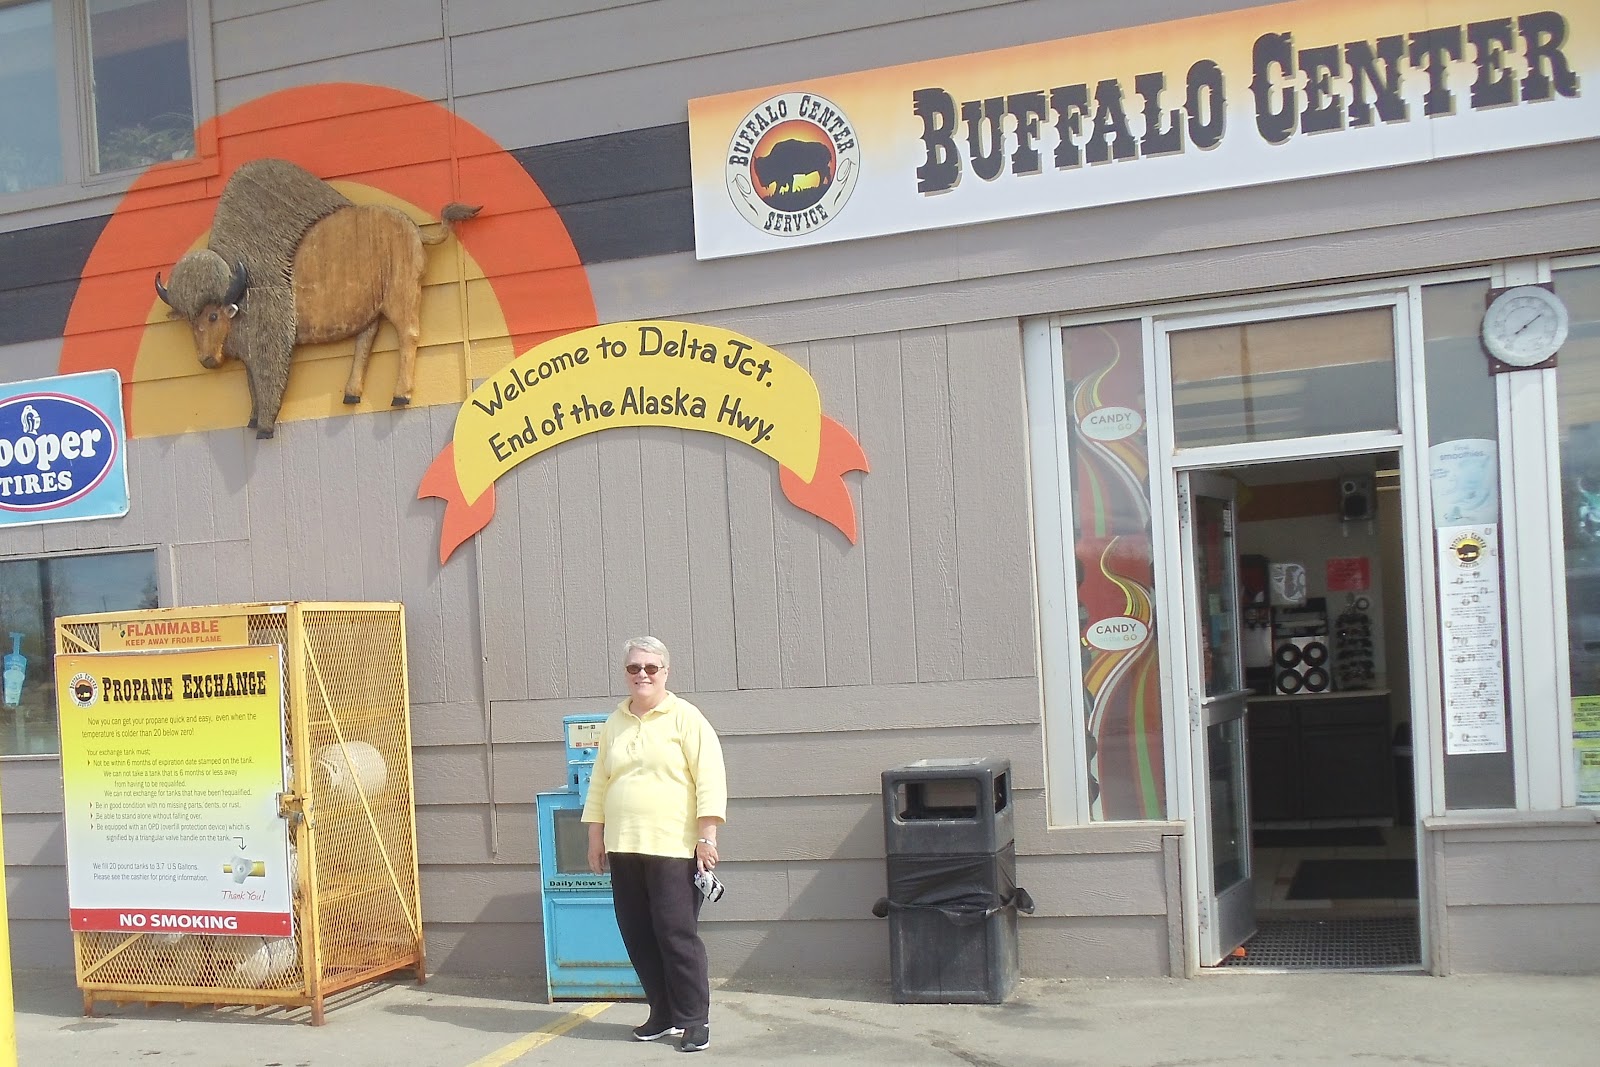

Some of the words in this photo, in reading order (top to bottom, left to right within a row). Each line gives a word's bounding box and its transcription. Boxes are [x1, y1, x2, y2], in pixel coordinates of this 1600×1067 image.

[912, 57, 1226, 197] BUFFALO
[1248, 10, 1580, 145] CENTER
[729, 100, 787, 166] BUFFALO
[799, 95, 855, 154] CENTER
[764, 203, 828, 232] SERVICE
[472, 343, 589, 417] Welcome
[597, 336, 627, 360] to
[638, 326, 716, 363] Delta
[724, 339, 773, 388] Jct.
[489, 416, 537, 462] End
[541, 402, 565, 437] of
[571, 395, 615, 426] the
[621, 386, 706, 420] Alaska
[717, 394, 775, 444] Hwy.
[1090, 413, 1131, 425] CANDY
[0, 428, 102, 471] ooper
[0, 470, 73, 497] TIRES
[127, 620, 219, 637] FLAMMABLE
[1096, 623, 1137, 635] CANDY
[125, 639, 146, 647] KEEP
[148, 637, 169, 646] AWAY
[171, 636, 193, 645] FROM
[195, 635, 222, 643] FLAME
[102, 676, 173, 703] PROPANE
[182, 671, 266, 700] EXCHANGE
[87, 717, 100, 726] Now
[100, 719, 110, 727] you
[122, 717, 132, 727] get
[132, 718, 145, 727] your
[145, 716, 169, 726] propane
[169, 715, 185, 724] quick
[186, 714, 198, 723] and
[215, 714, 230, 722] even
[230, 712, 246, 721] when
[247, 712, 257, 721] the
[81, 730, 115, 739] temperature
[121, 729, 138, 738] colder
[139, 729, 152, 738] than
[162, 728, 179, 737] below
[98, 748, 123, 757] exchange
[123, 748, 135, 756] tank
[93, 759, 103, 767] Not
[158, 758, 185, 767] expiration
[184, 758, 197, 766] date
[198, 757, 221, 766] stamped
[230, 757, 239, 765] the
[221, 890, 246, 901] Thank
[246, 889, 266, 902] You!
[119, 913, 147, 927] NO
[150, 914, 238, 930] SMOKING
